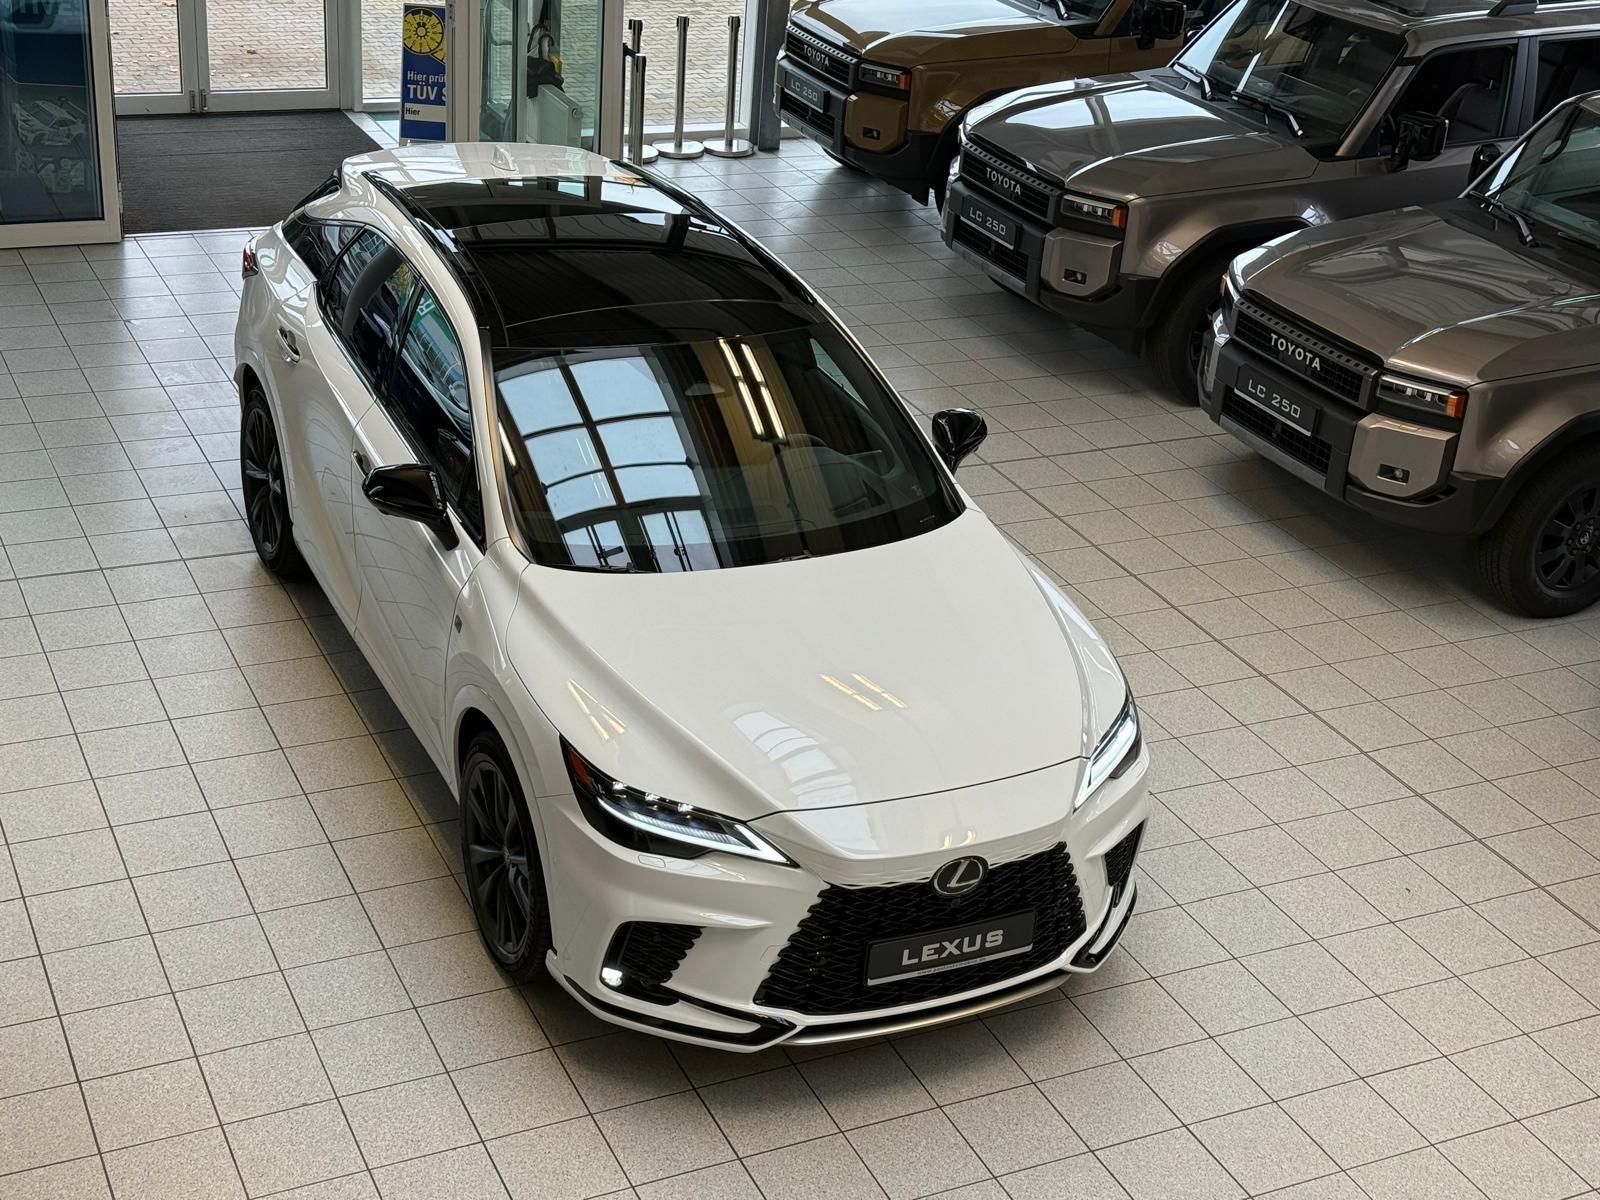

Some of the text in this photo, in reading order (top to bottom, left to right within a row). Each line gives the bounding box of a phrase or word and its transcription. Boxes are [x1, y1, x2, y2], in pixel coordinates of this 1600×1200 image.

[802, 44, 830, 67] TOYOTA
[407, 70, 426, 81] Hier
[407, 81, 438, 101] TÜV
[790, 79, 818, 101] LC 250
[405, 106, 421, 116] Hier
[985, 167, 1022, 195] TOYOTA
[969, 206, 1006, 236] LC 250
[1270, 333, 1321, 371] TOYOTA
[1248, 379, 1301, 419] LC 250
[902, 929, 1004, 966] LEXUS
